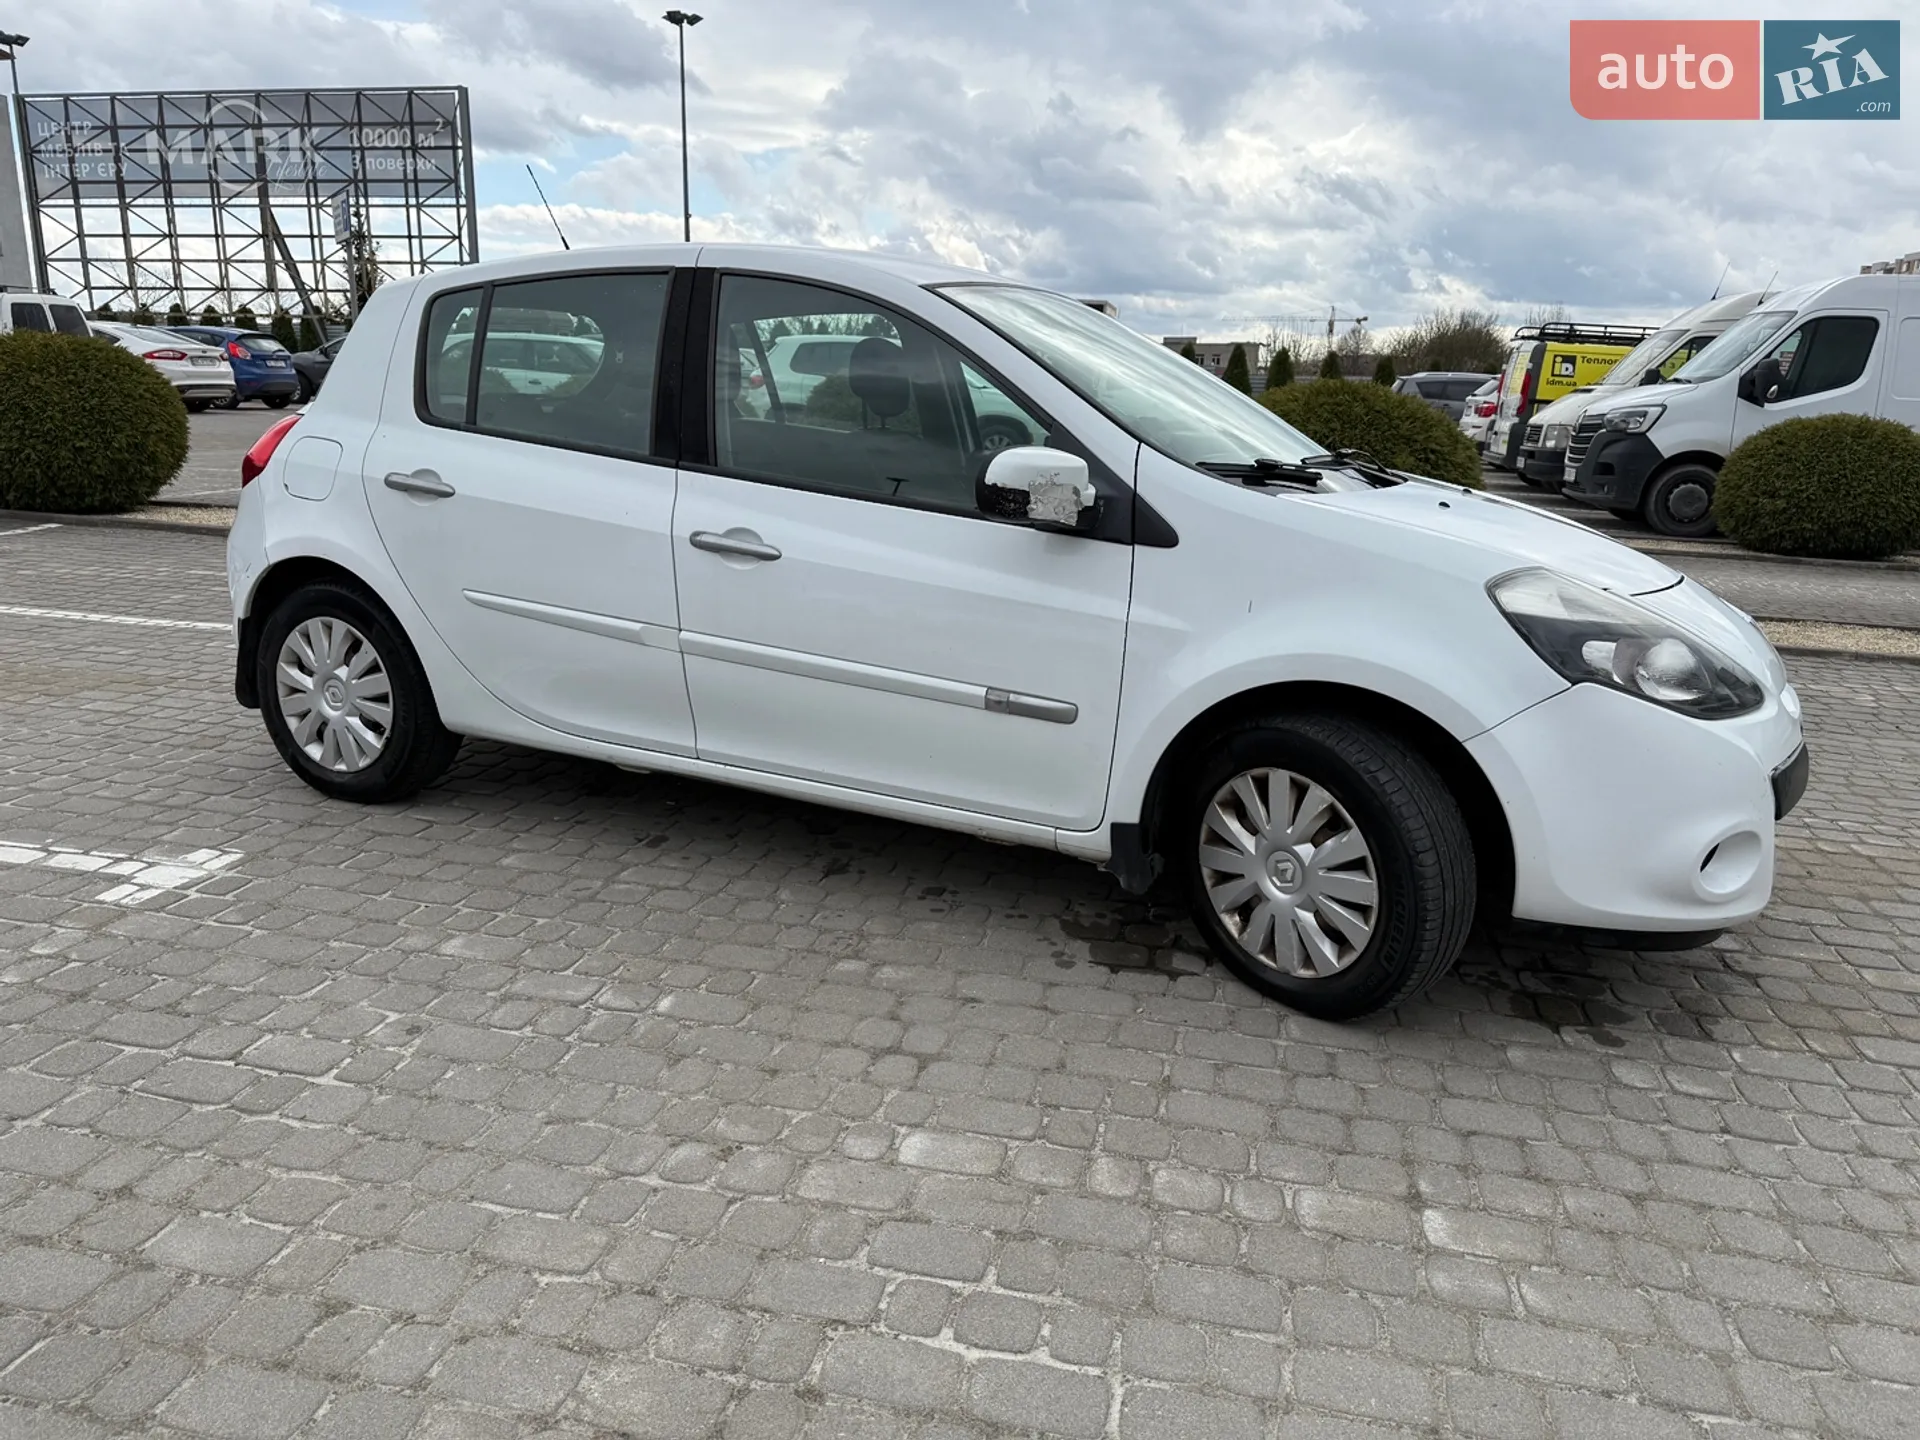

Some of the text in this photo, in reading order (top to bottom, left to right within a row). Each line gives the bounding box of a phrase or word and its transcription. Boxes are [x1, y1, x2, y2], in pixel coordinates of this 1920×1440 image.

[37, 121, 92, 139] ЦЕНТР
[349, 127, 412, 148] 10000
[40, 141, 131, 158] МЕБЛІВ ТА
[145, 127, 325, 165] MARK
[351, 154, 437, 174] 3 поверхи
[1546, 378, 1577, 387] idm.ua
